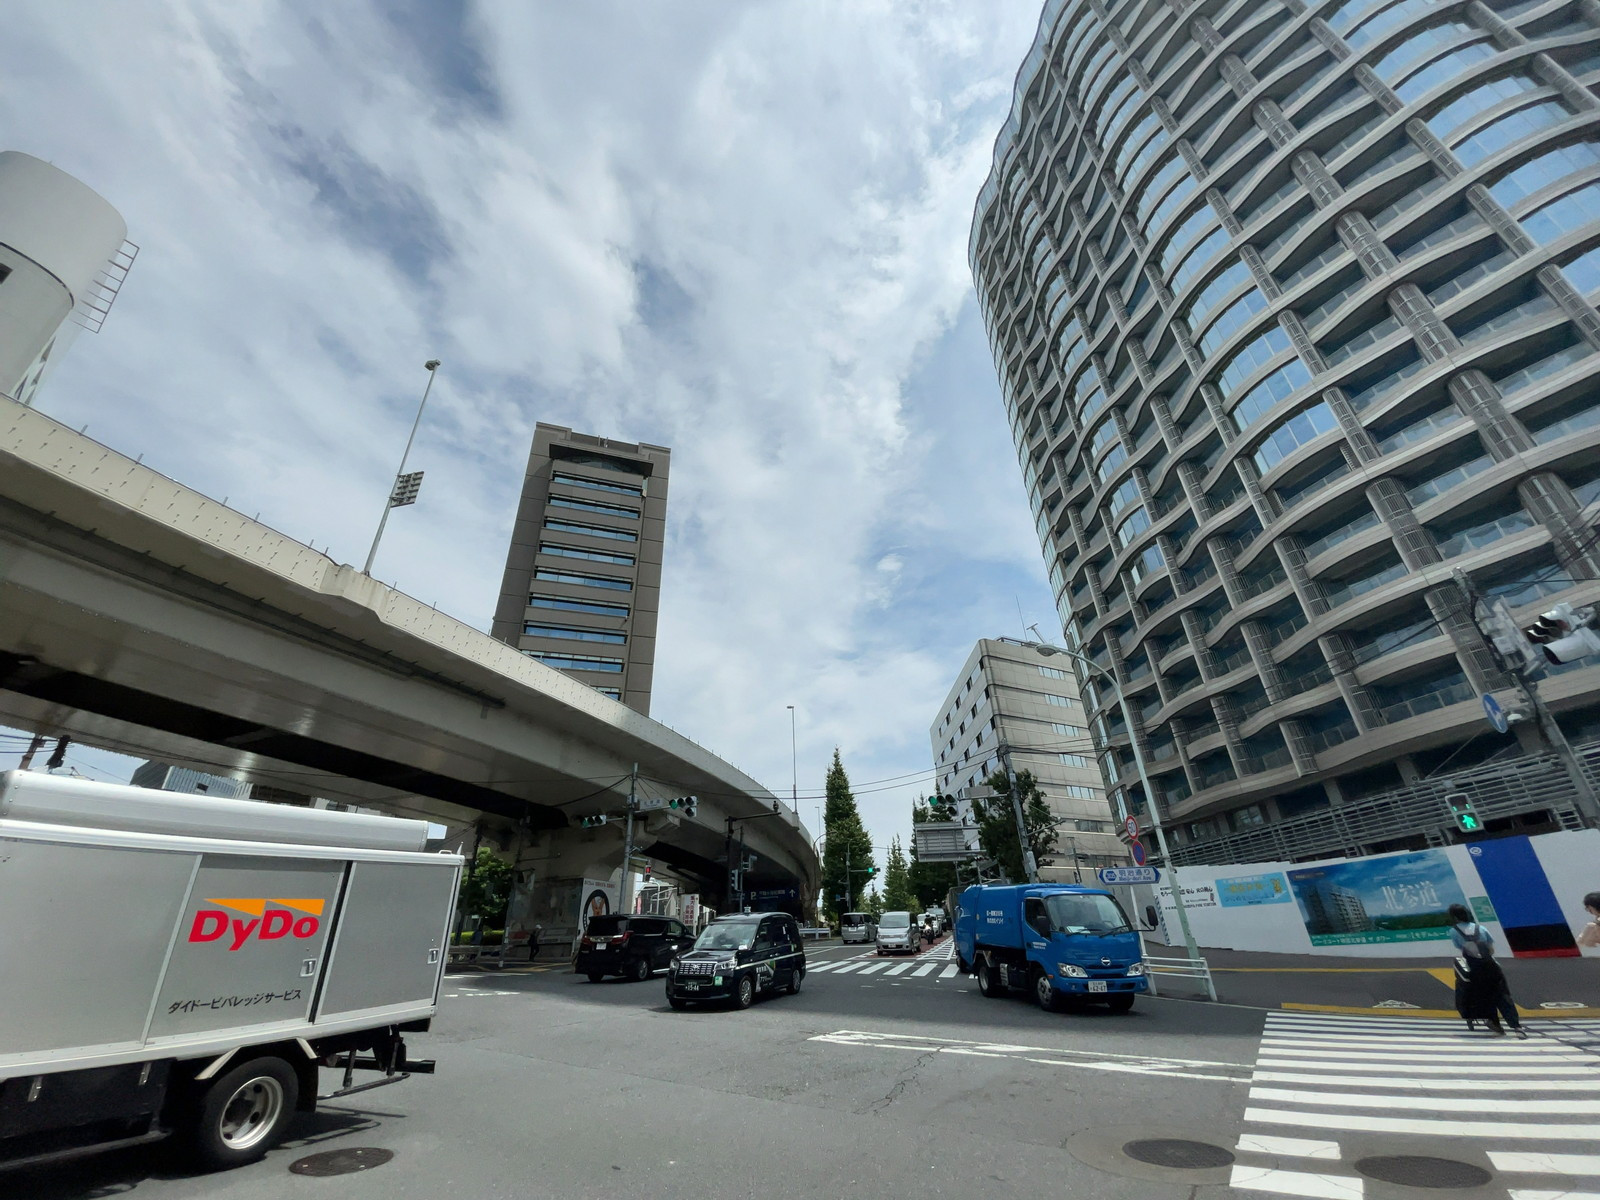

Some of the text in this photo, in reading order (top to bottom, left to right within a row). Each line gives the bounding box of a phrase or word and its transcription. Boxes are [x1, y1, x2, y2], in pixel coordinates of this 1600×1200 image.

[1127, 821, 1136, 833] 50
[1119, 869, 1150, 877] 明治通り
[1381, 880, 1442, 910] 北参道
[188, 909, 320, 952] DyDo
[168, 989, 302, 1014] ダイドービバレッジサービス
